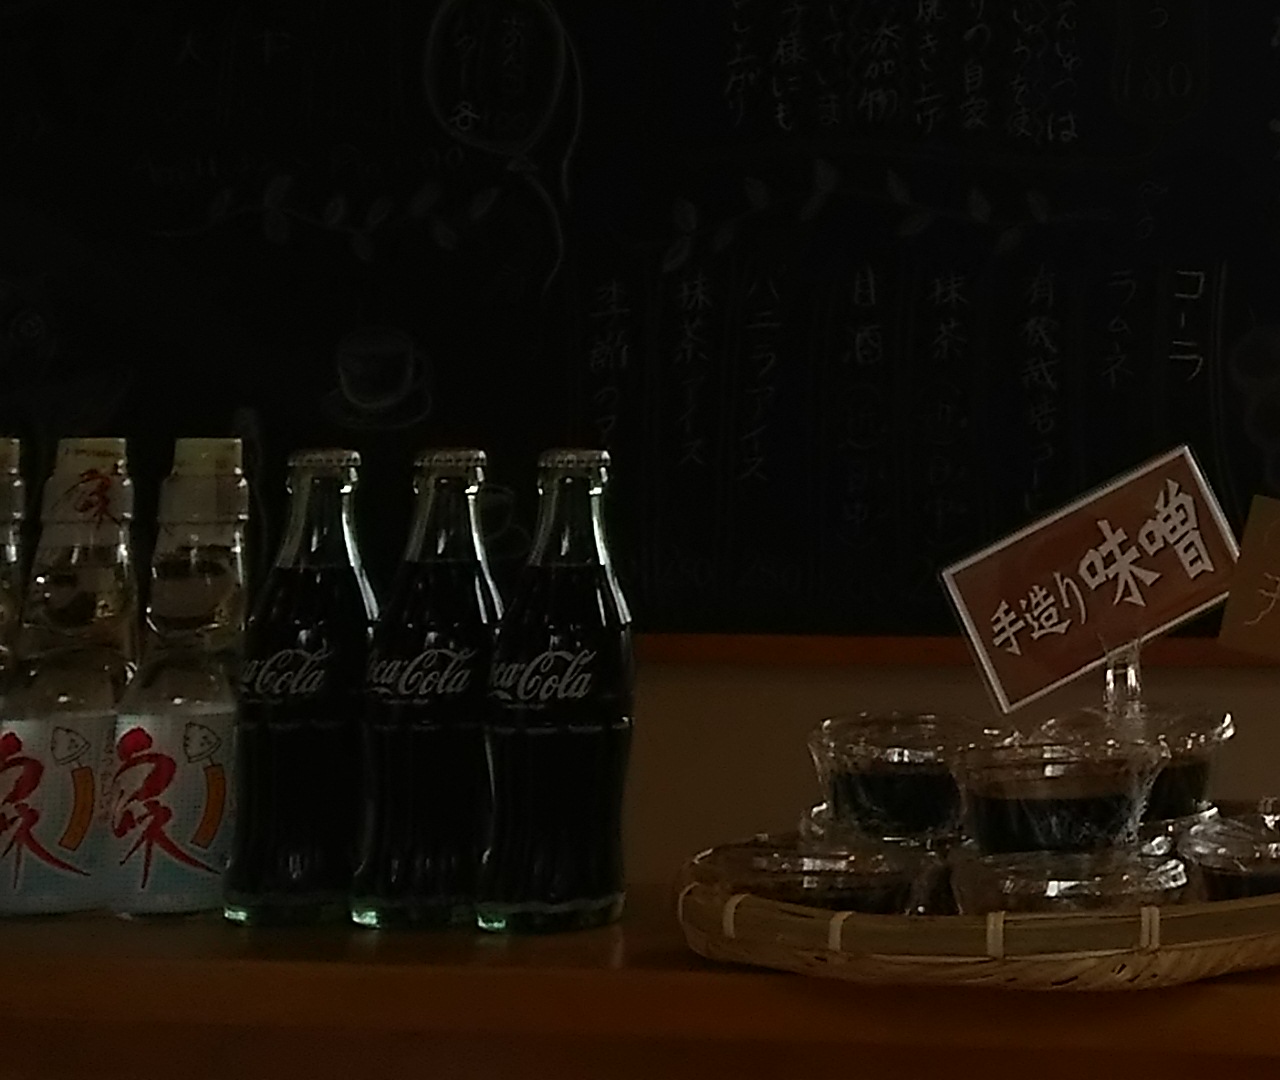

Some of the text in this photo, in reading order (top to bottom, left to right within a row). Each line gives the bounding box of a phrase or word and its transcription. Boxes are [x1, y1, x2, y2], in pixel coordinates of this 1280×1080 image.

[1101, 268, 1136, 389] ラムネ
[1168, 270, 1205, 382] コーラ
